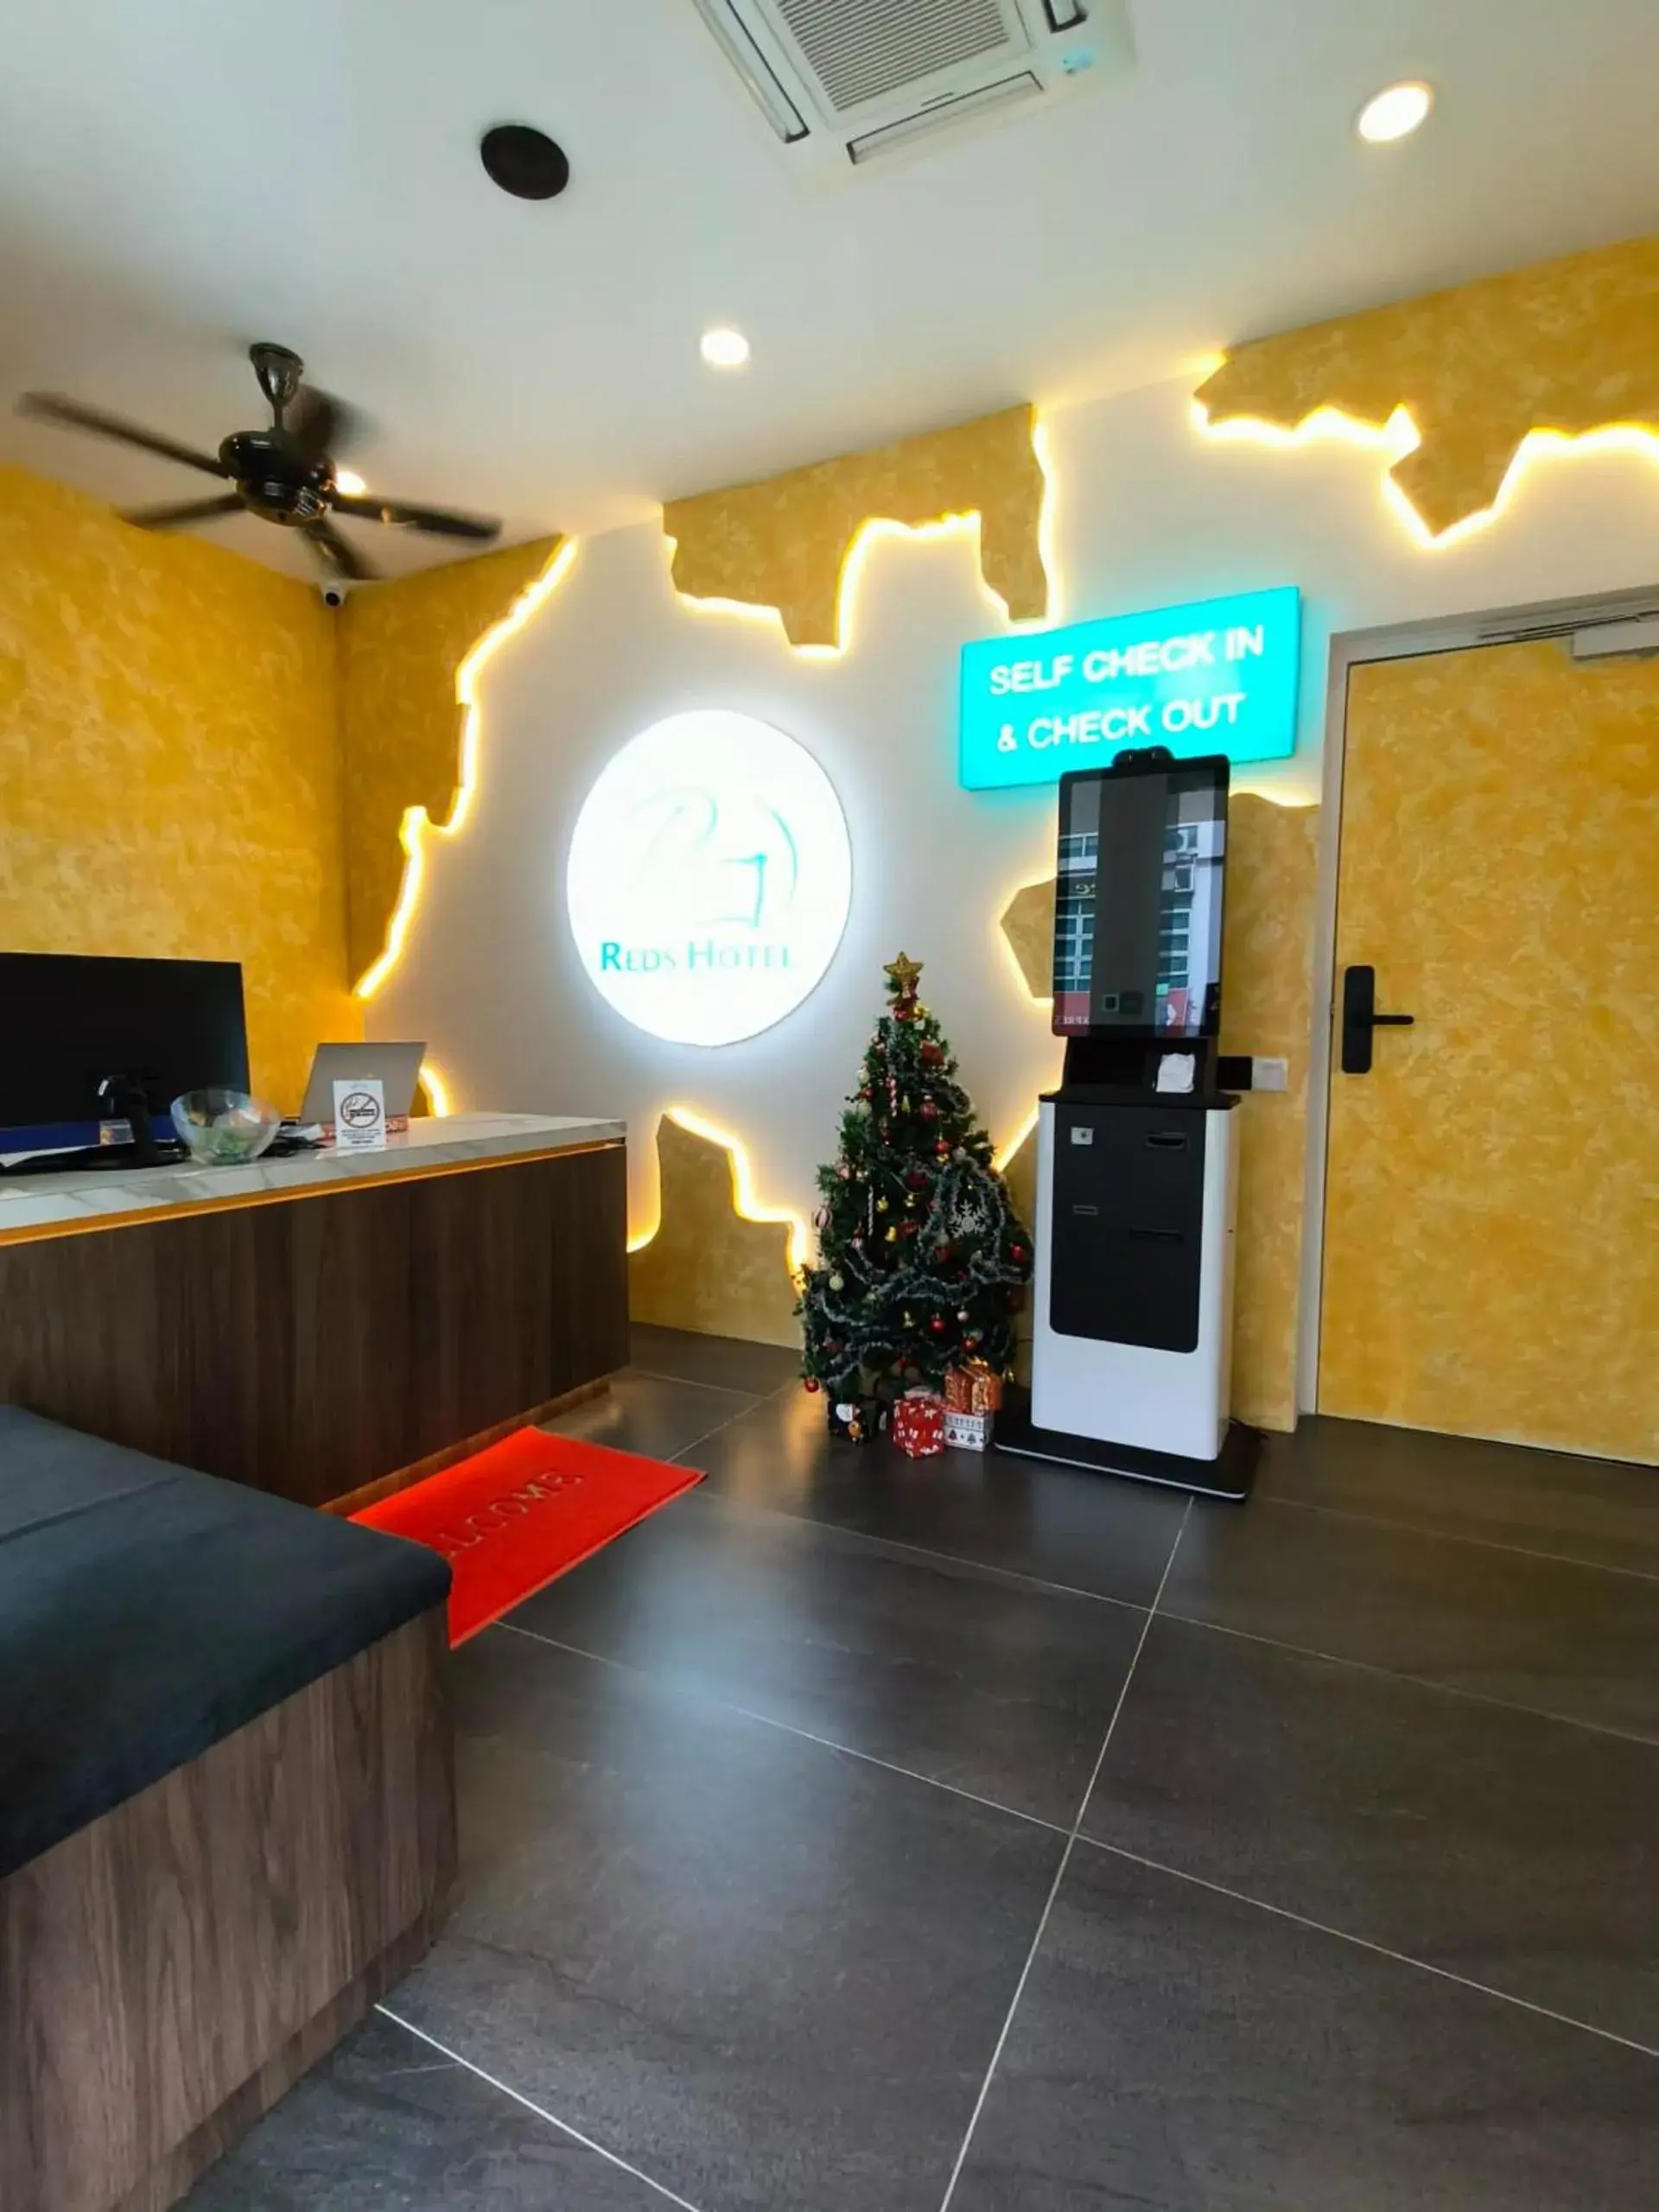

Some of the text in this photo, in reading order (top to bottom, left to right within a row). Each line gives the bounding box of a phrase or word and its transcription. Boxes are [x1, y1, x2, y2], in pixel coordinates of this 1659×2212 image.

[990, 626, 1264, 694] SELF CHECK IN
[996, 695, 1245, 753] & CHECK OUT
[601, 938, 792, 972] REDS HOTEL
[438, 1471, 584, 1557] LCOME
